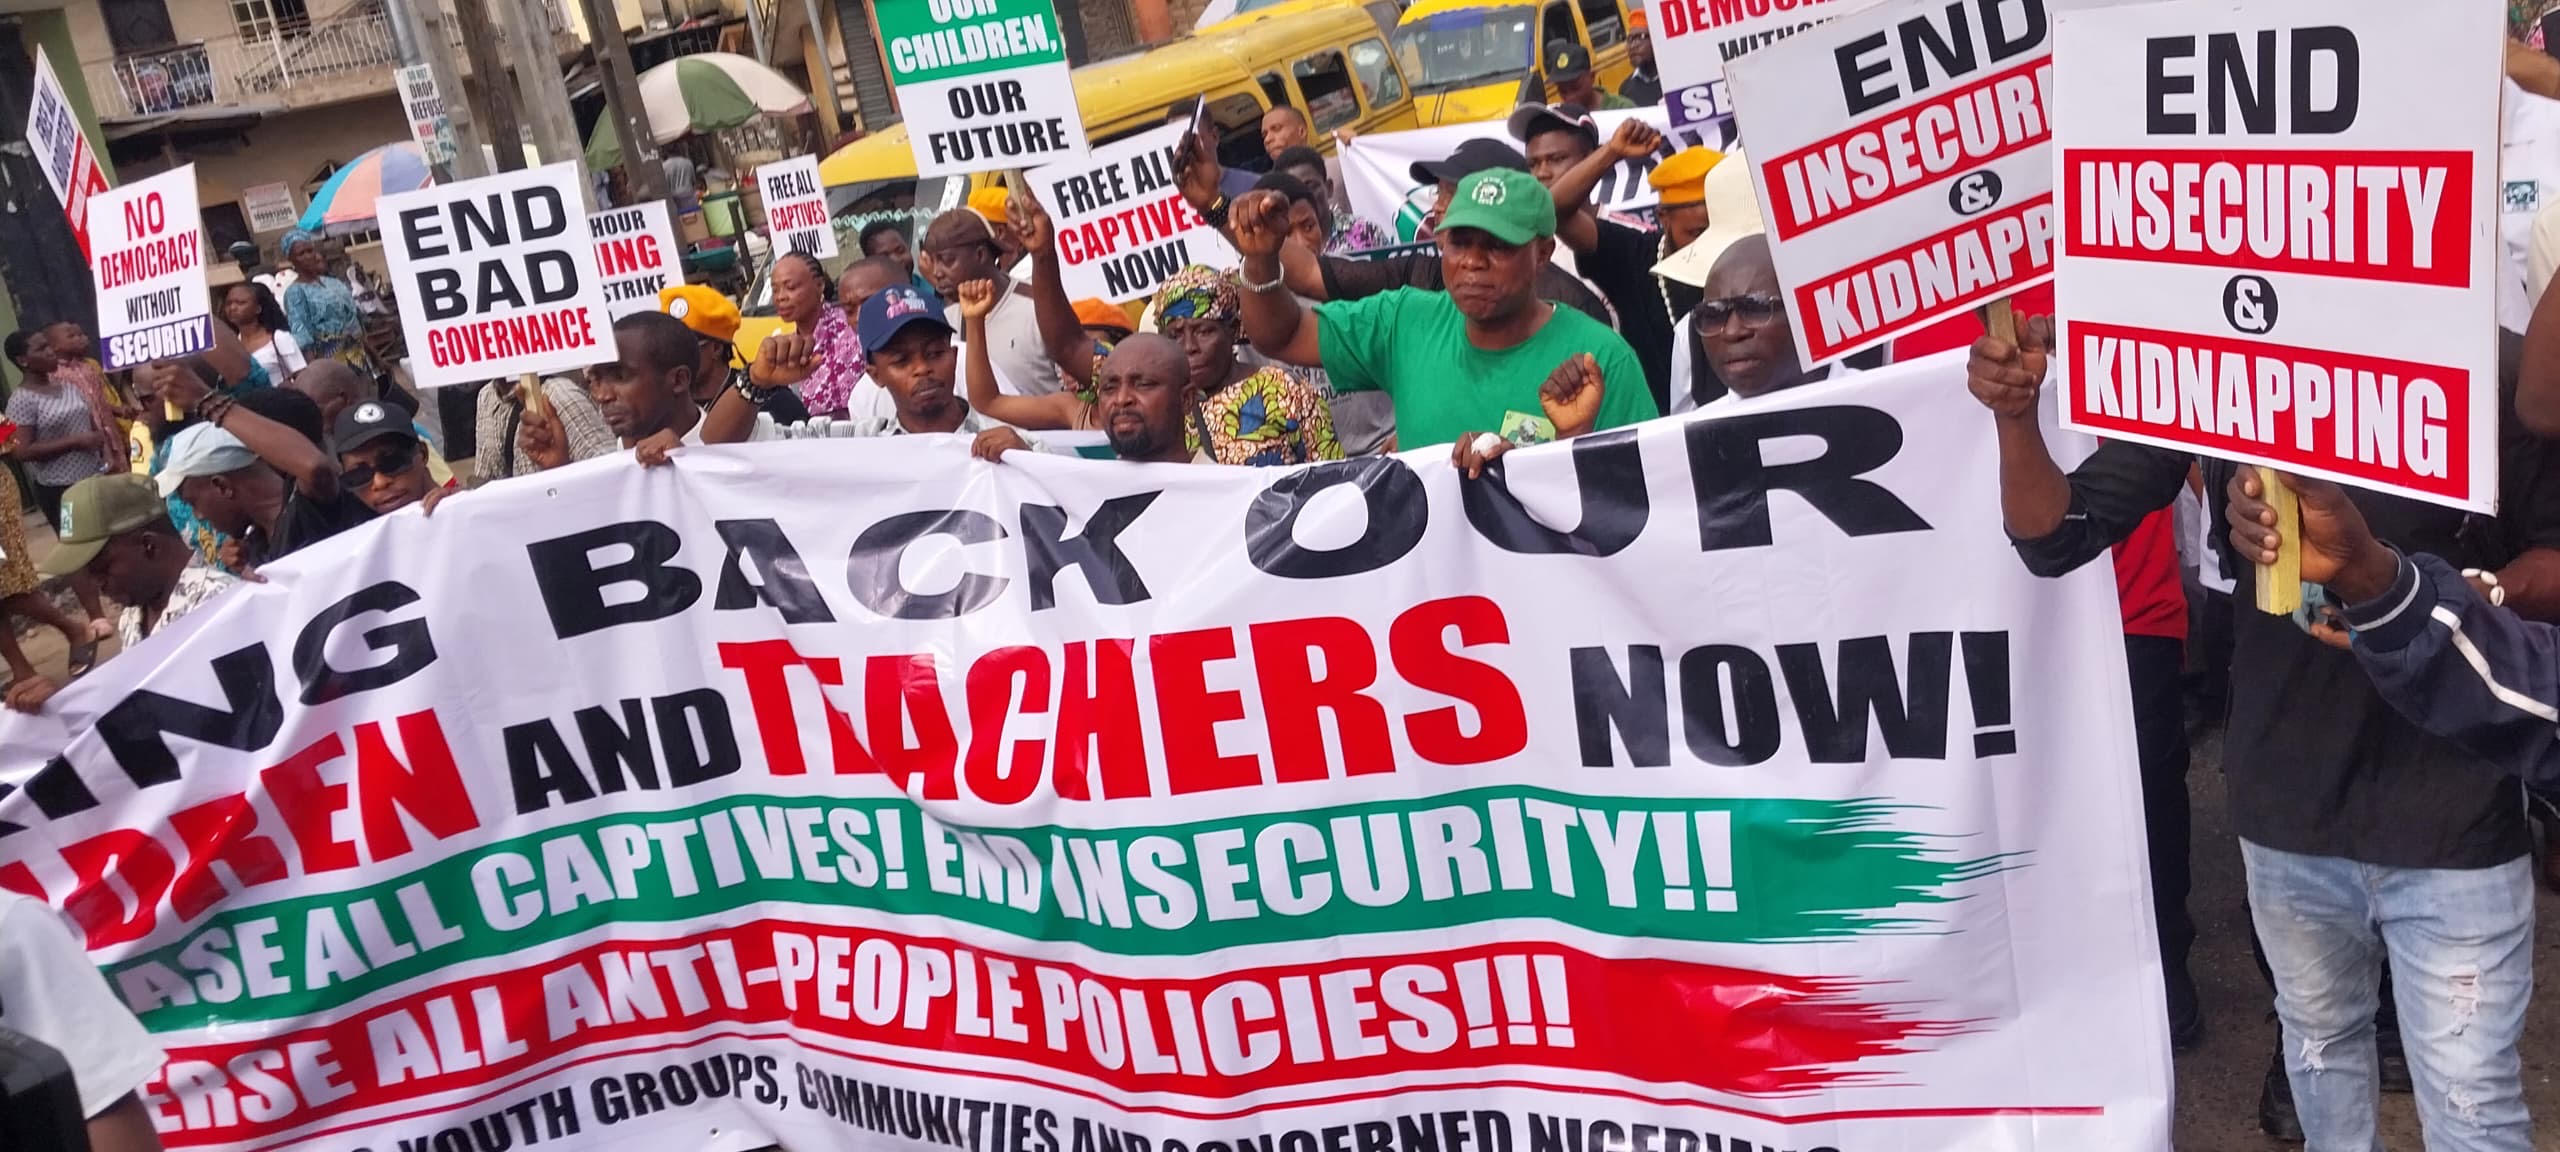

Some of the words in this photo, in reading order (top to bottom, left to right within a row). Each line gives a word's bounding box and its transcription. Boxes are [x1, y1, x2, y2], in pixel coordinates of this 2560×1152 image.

[890, 13, 1058, 74] CHILDREN,
[1834, 0, 2049, 118] END
[408, 80, 433, 99] DROP
[410, 98, 446, 120] REFUSE
[948, 80, 1027, 119] OUR
[2146, 25, 2360, 136] END
[928, 118, 1069, 164] FUTURE
[768, 173, 796, 202] FREE
[795, 168, 815, 196] ALL
[1052, 162, 1129, 220] FREE
[1959, 171, 1994, 215] &
[124, 192, 165, 241] NO
[399, 186, 567, 262] END
[589, 210, 646, 238] HOUR
[771, 199, 826, 232] CAPTIVES
[789, 228, 823, 256] NOW!
[2080, 160, 2448, 269] INSECURITY
[101, 230, 198, 290] DEMOCRACY
[416, 249, 579, 322] BAD
[594, 235, 662, 278] ING
[125, 287, 183, 324] WITHOUT
[2233, 277, 2268, 332] &
[109, 316, 207, 368] SECURITY
[428, 307, 596, 368] GOVERNANCE
[2083, 334, 2448, 480] KIDNAPPING
[0, 581, 439, 838] ING
[526, 490, 1165, 640] BACK
[1245, 404, 1935, 578] OUR
[0, 708, 480, 951] DREN
[502, 686, 742, 815] AND
[717, 595, 1528, 806] TEACHERS
[1570, 630, 2017, 767] NOW!
[305, 882, 464, 990] ALL
[470, 806, 908, 932] CAPTIVES!
[921, 811, 1042, 914] END
[1050, 797, 1738, 930] INSECURITY!!
[369, 988, 528, 1088] ALL
[548, 928, 1031, 1047] ANTI-PEOPLE
[1034, 953, 1576, 1078] POLICIES!!!
[590, 1053, 788, 1125] GROUPS,
[795, 1060, 1059, 1152] COMMUNITIES
